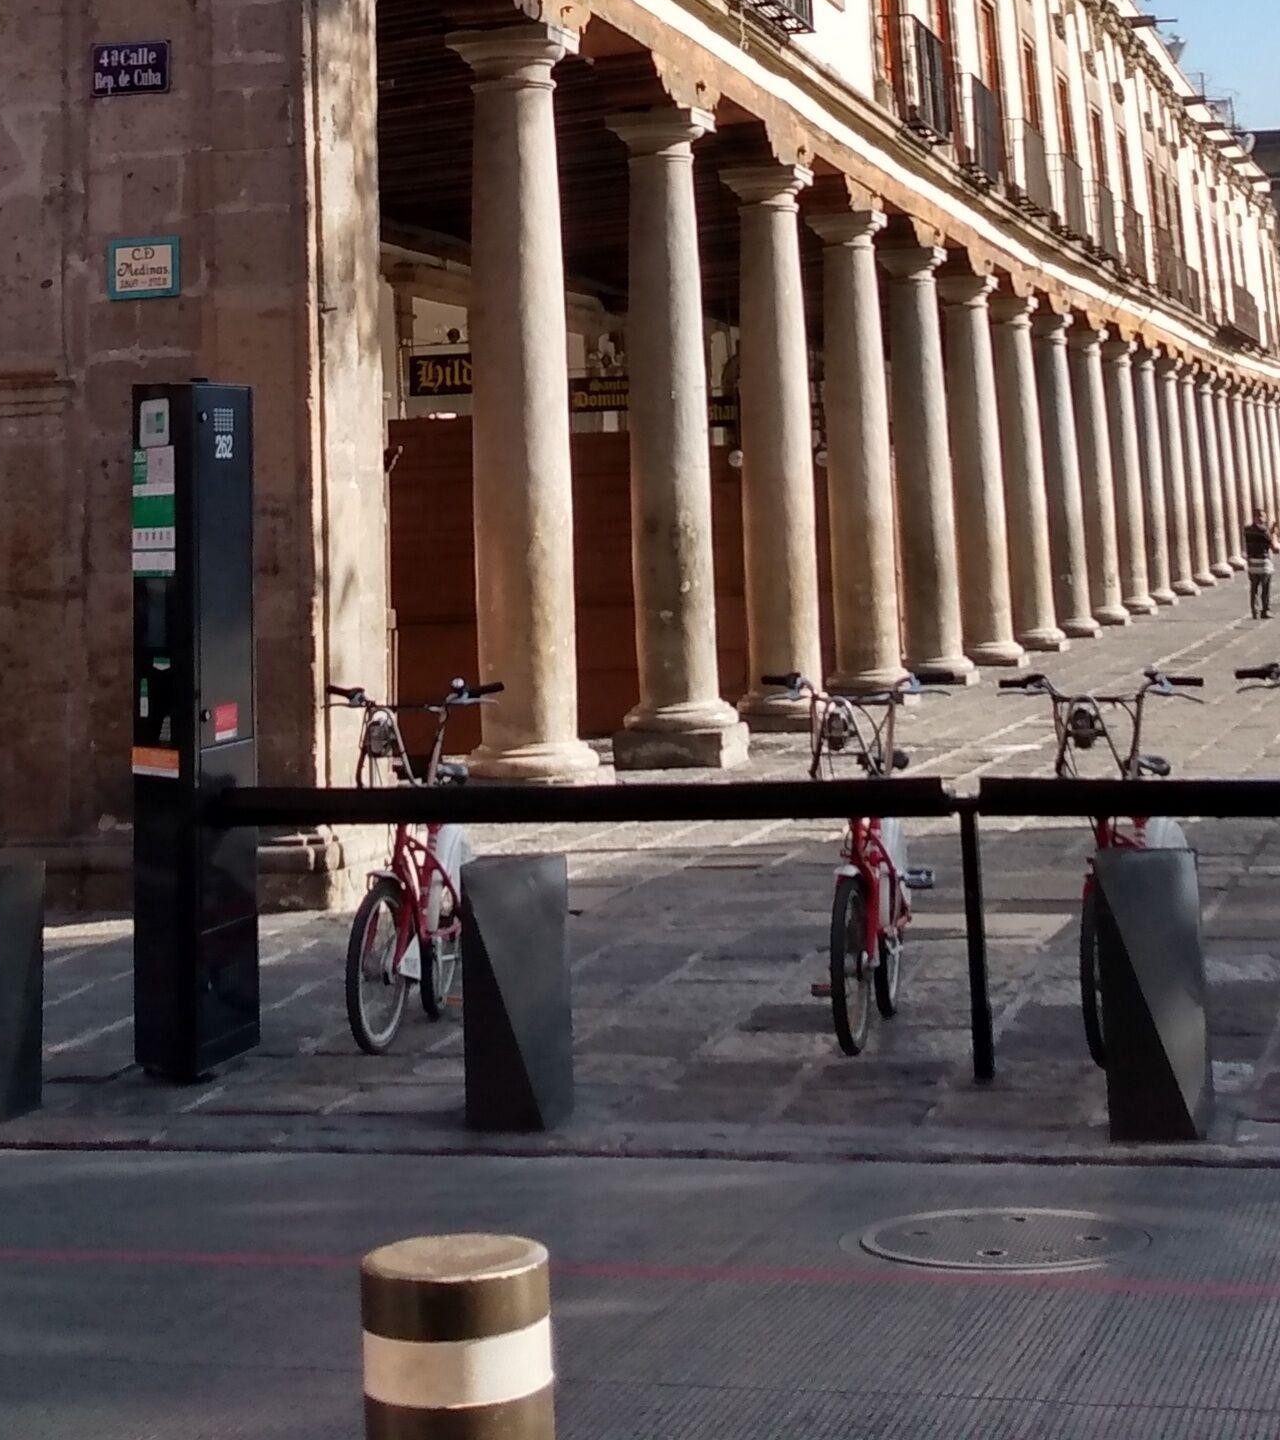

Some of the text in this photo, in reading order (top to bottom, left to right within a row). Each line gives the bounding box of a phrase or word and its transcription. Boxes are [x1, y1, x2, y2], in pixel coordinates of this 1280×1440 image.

[120, 47, 157, 66] Calle
[94, 68, 162, 95] Rep. de Cuba
[215, 434, 233, 459] 262
